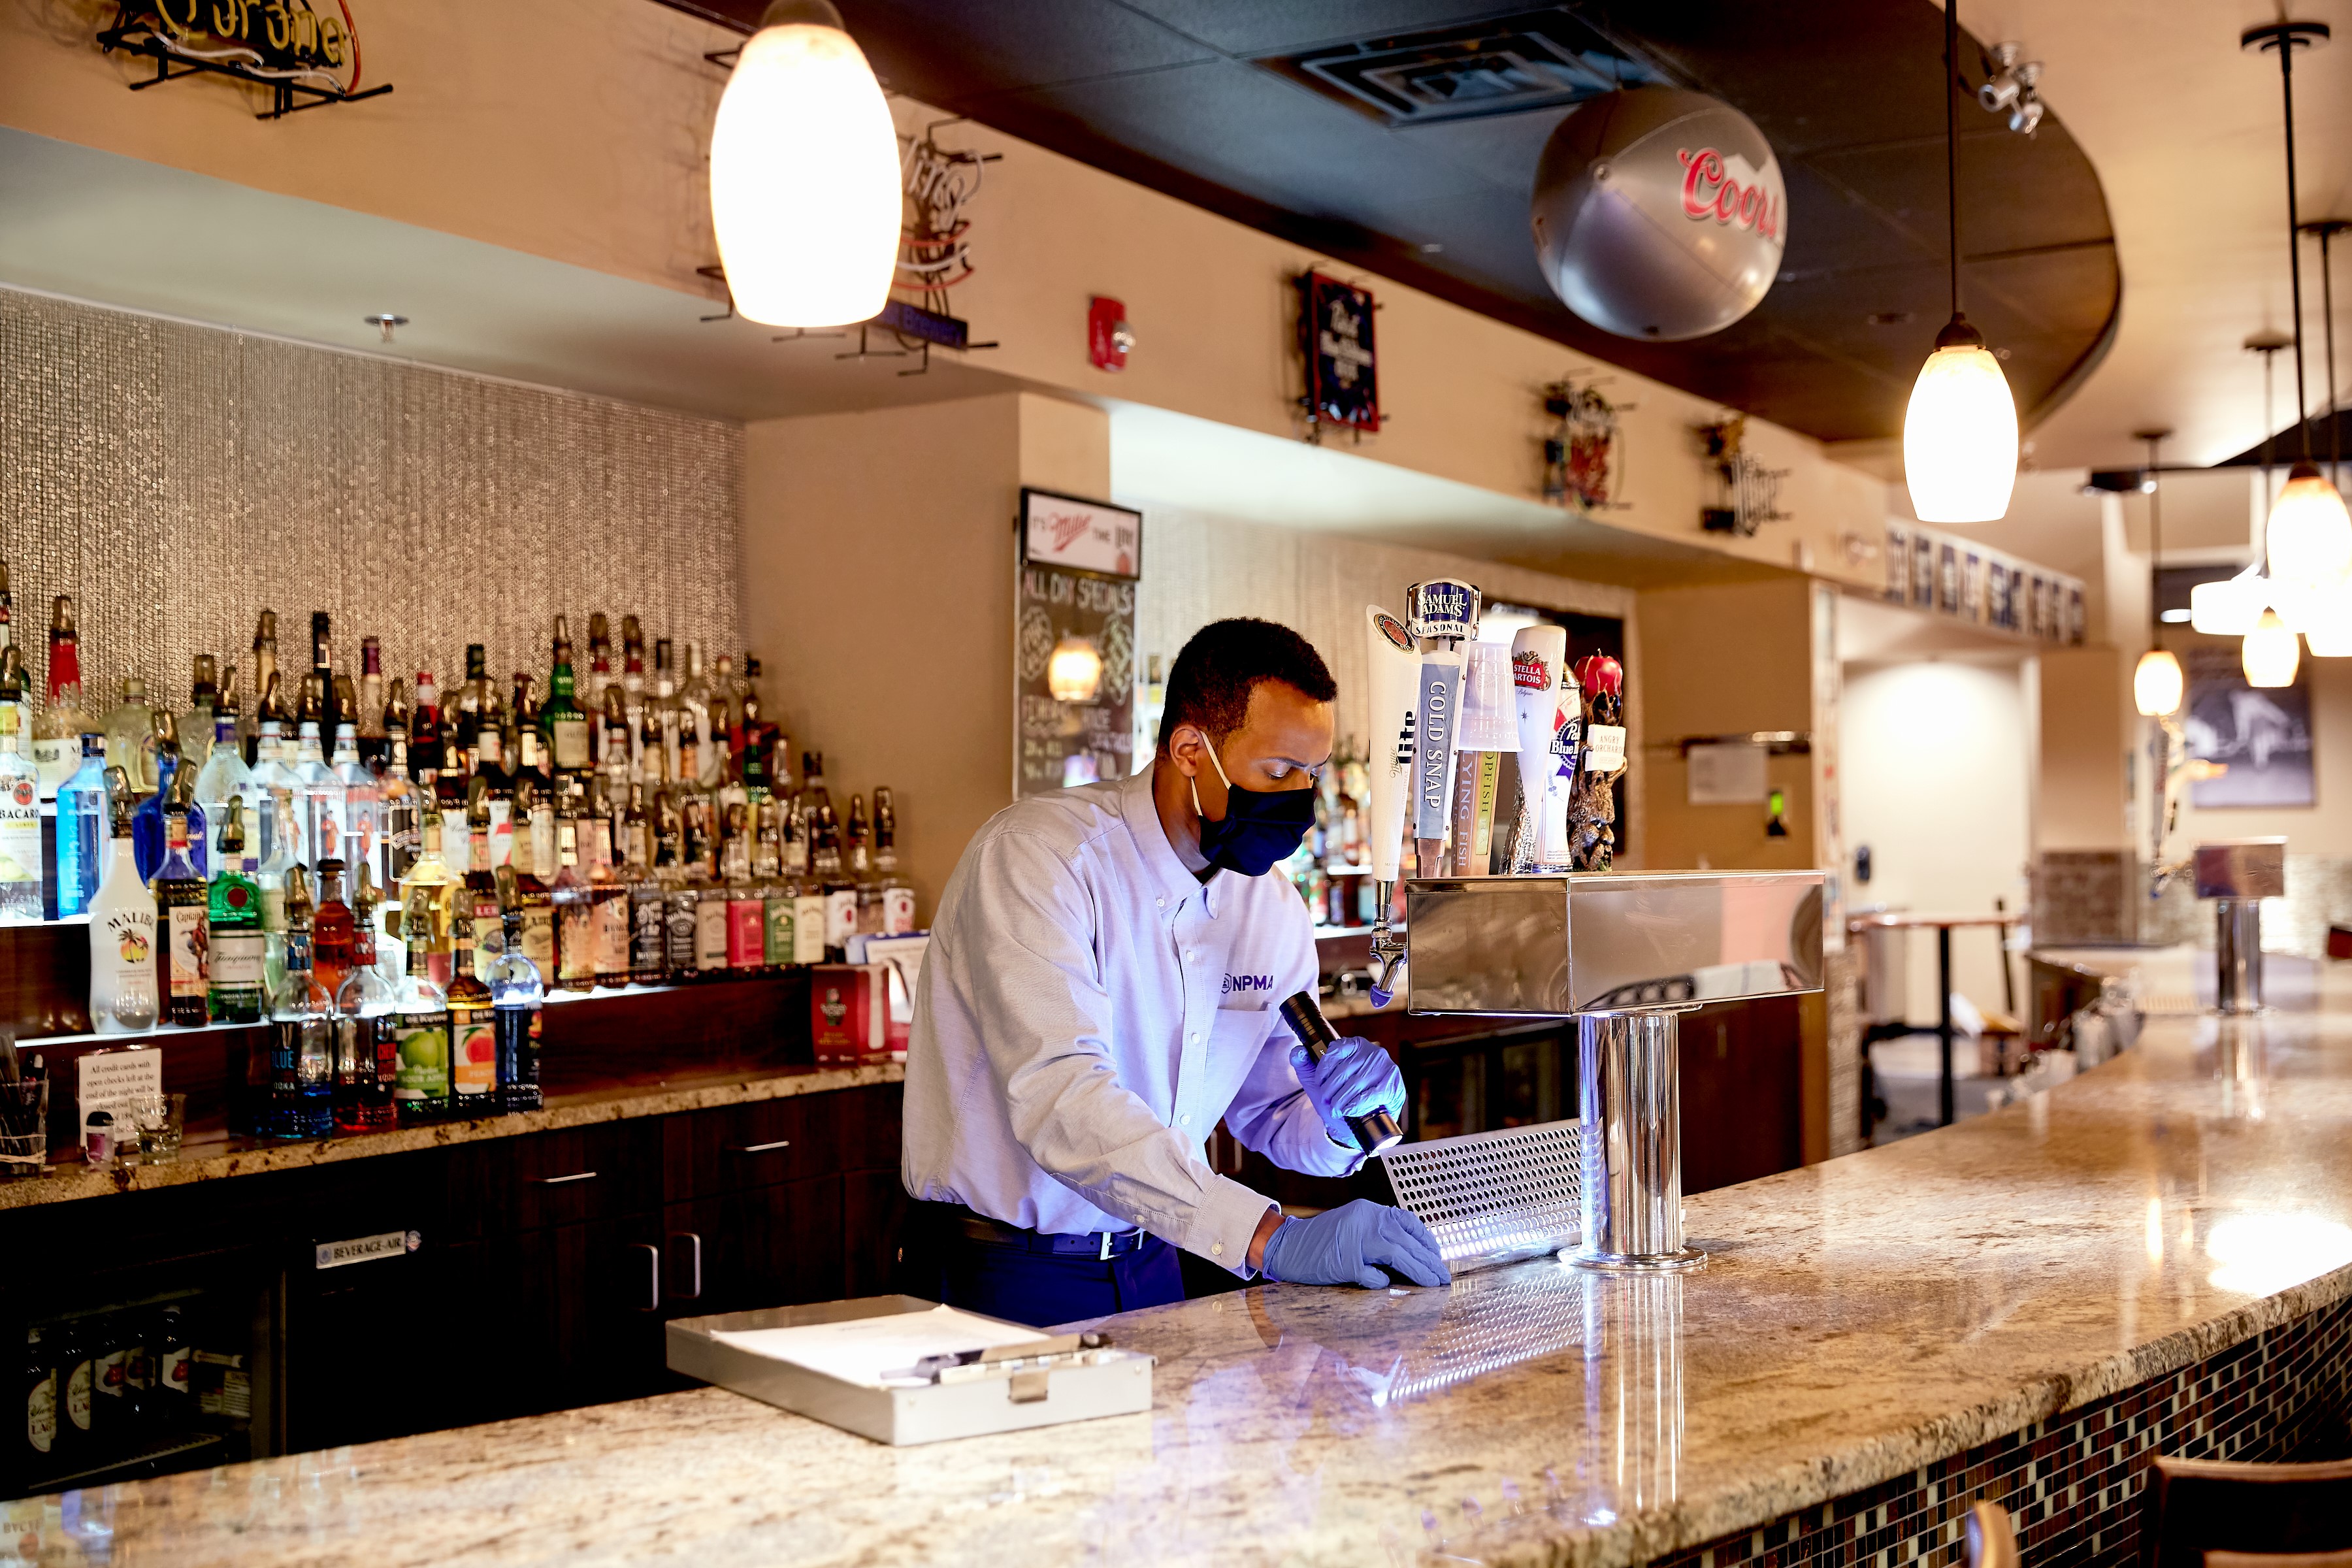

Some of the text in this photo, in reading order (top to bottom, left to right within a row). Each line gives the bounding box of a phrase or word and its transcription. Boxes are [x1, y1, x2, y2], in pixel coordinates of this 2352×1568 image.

[1677, 148, 1778, 239] Coors
[1418, 592, 1467, 608] SAMUEL
[1420, 604, 1463, 617] ADAMS
[1416, 623, 1464, 634] SEASONAL
[1514, 664, 1541, 676] STELLA
[1513, 674, 1541, 684] ARTOIS
[1424, 681, 1446, 808] COLD SNAP
[1600, 735, 1620, 744] ANGRY
[1550, 740, 1574, 755] Blue
[1595, 744, 1624, 754] ORCHARD
[1389, 746, 1403, 778] Miller
[1481, 751, 1496, 813] OPFISH
[1458, 751, 1474, 867] LYING FISH
[1232, 975, 1273, 991] NPMA
[91, 1065, 100, 1073] All
[101, 1064, 118, 1072] credit
[120, 1062, 136, 1070] cards
[104, 1076, 124, 1085] checks
[118, 1087, 133, 1096] night
